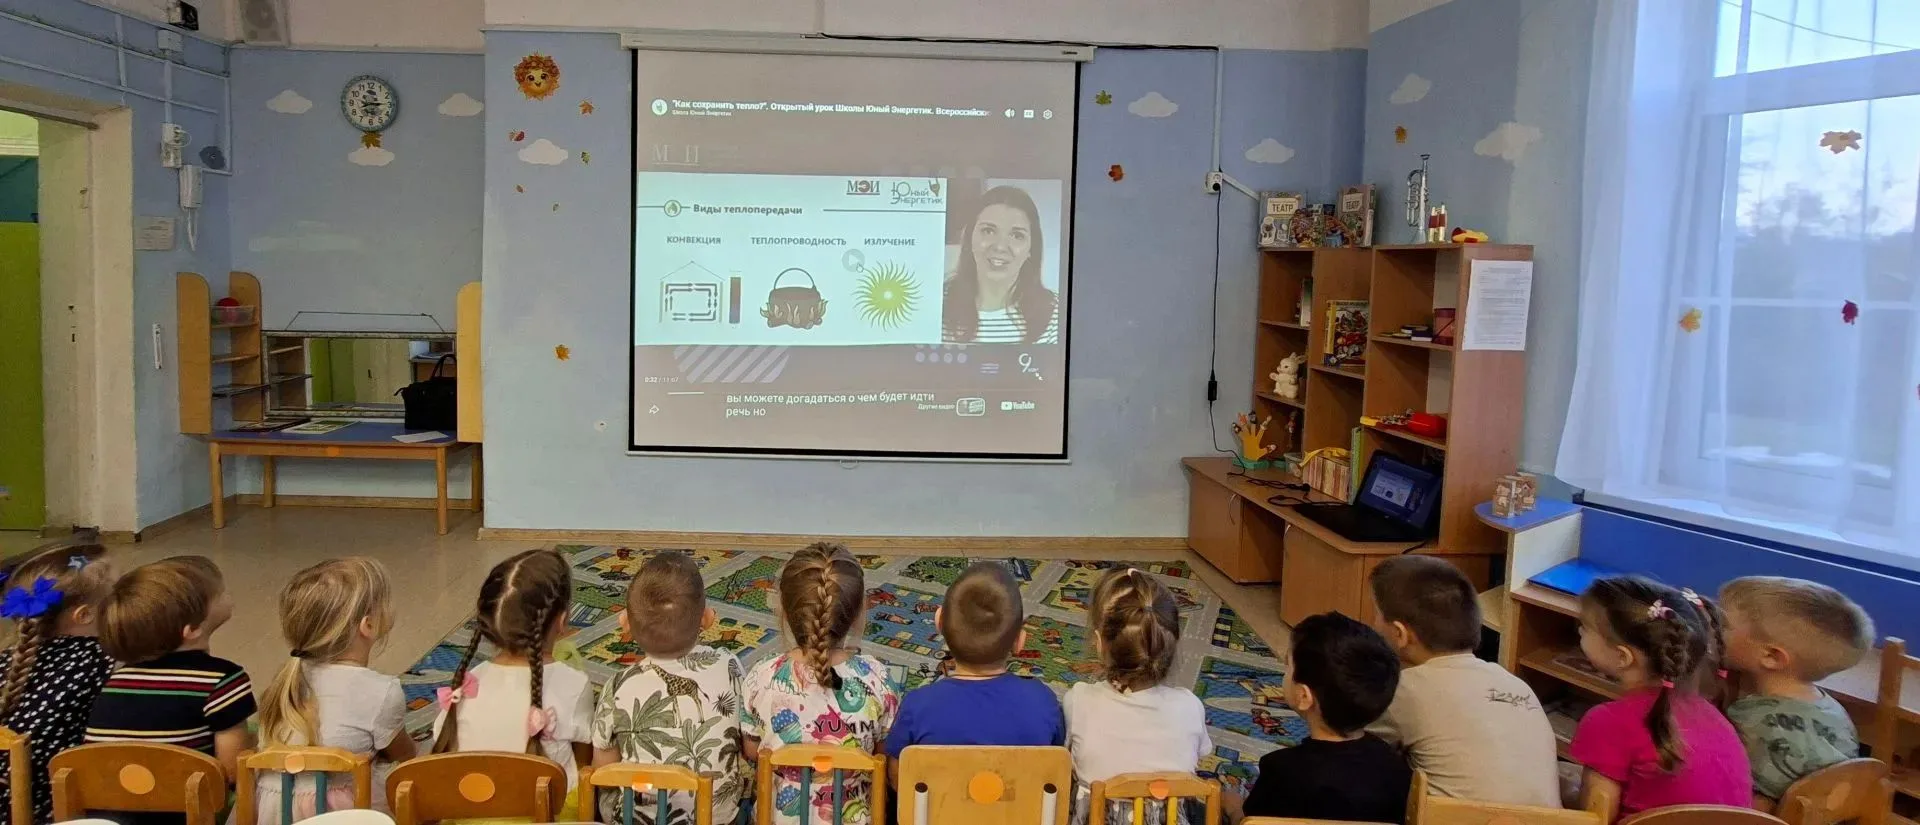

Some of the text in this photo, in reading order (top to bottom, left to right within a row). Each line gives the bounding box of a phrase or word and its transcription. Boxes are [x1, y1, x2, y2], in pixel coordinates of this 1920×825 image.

[693, 101, 734, 111] сохранить
[770, 102, 814, 113] Открытый
[815, 104, 834, 114] урок
[835, 104, 864, 113] Школы
[866, 104, 890, 114] Юный
[847, 179, 881, 193] МЭИ
[891, 181, 929, 197] Юный
[693, 204, 803, 217] Виды теплопередачи
[1272, 203, 1294, 213] ТЕАТР
[666, 235, 722, 246] КОНВЕКЦИЯ
[751, 236, 847, 247] ТЕПЛОПРОВОДНОСТЬ
[864, 237, 916, 247] ИЗЛУЧЕНИЕ
[726, 391, 935, 405] вы можете догадаться о чем будет идти
[1013, 401, 1035, 410] YouTube
[726, 407, 766, 419] речь но
